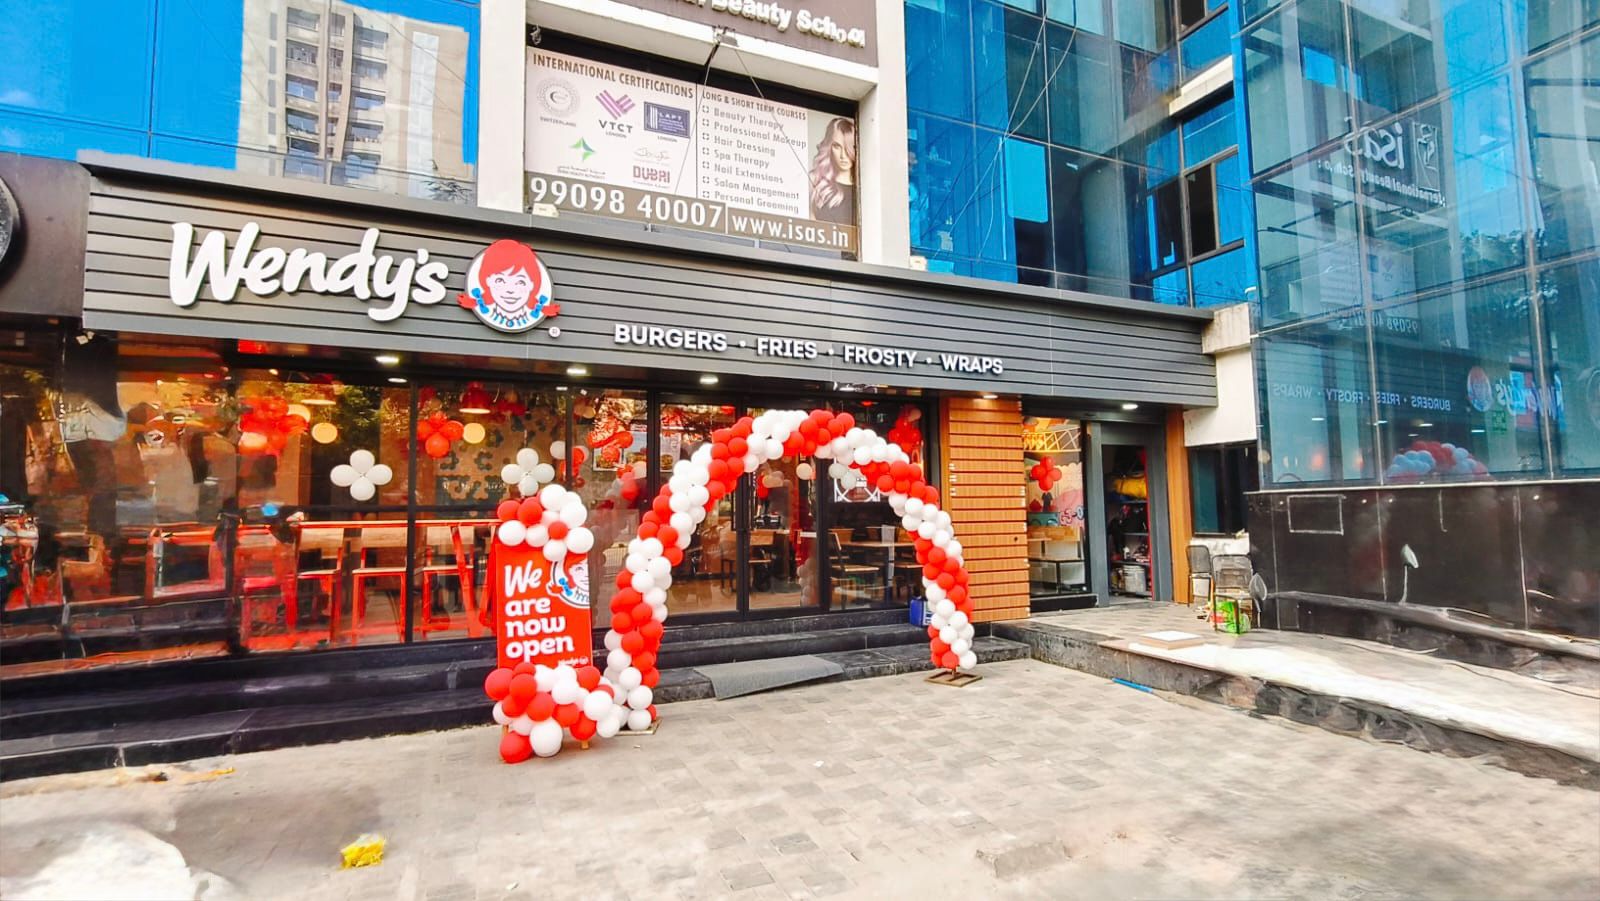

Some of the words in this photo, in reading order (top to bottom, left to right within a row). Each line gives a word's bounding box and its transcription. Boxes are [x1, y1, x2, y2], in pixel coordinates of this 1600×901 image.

[533, 53, 615, 83] INTERNATIONAL
[618, 73, 694, 99] CERTIFICATIONS
[702, 88, 722, 102] LONG
[732, 97, 754, 110] SHORT
[756, 103, 775, 113] TERM
[776, 107, 806, 120] COURSES
[598, 119, 634, 134] VTCT
[714, 108, 745, 123] Beauty
[749, 114, 783, 130] Therapy
[714, 121, 770, 141] Professional
[773, 134, 807, 149] Makeup
[714, 135, 733, 146] Hair
[736, 139, 776, 157] Dressing
[714, 149, 731, 161] Spa
[734, 153, 770, 169] Therapy
[714, 163, 732, 174] Nail
[735, 167, 783, 184] Extensions
[714, 178, 739, 190] Salon
[530, 177, 625, 214] 99098
[637, 194, 723, 228] 40007
[714, 191, 754, 205] Personal
[756, 198, 799, 214] Grooming
[732, 215, 849, 248] www.isas.in
[169, 222, 449, 322] Wendy's
[614, 323, 728, 352] BURGERS
[756, 337, 818, 359] FRIES
[843, 345, 917, 368] FROSTY
[940, 353, 1004, 375] WRAPS
[504, 560, 543, 598] We
[505, 597, 551, 617] are
[505, 616, 566, 638] now
[505, 636, 575, 664] open
